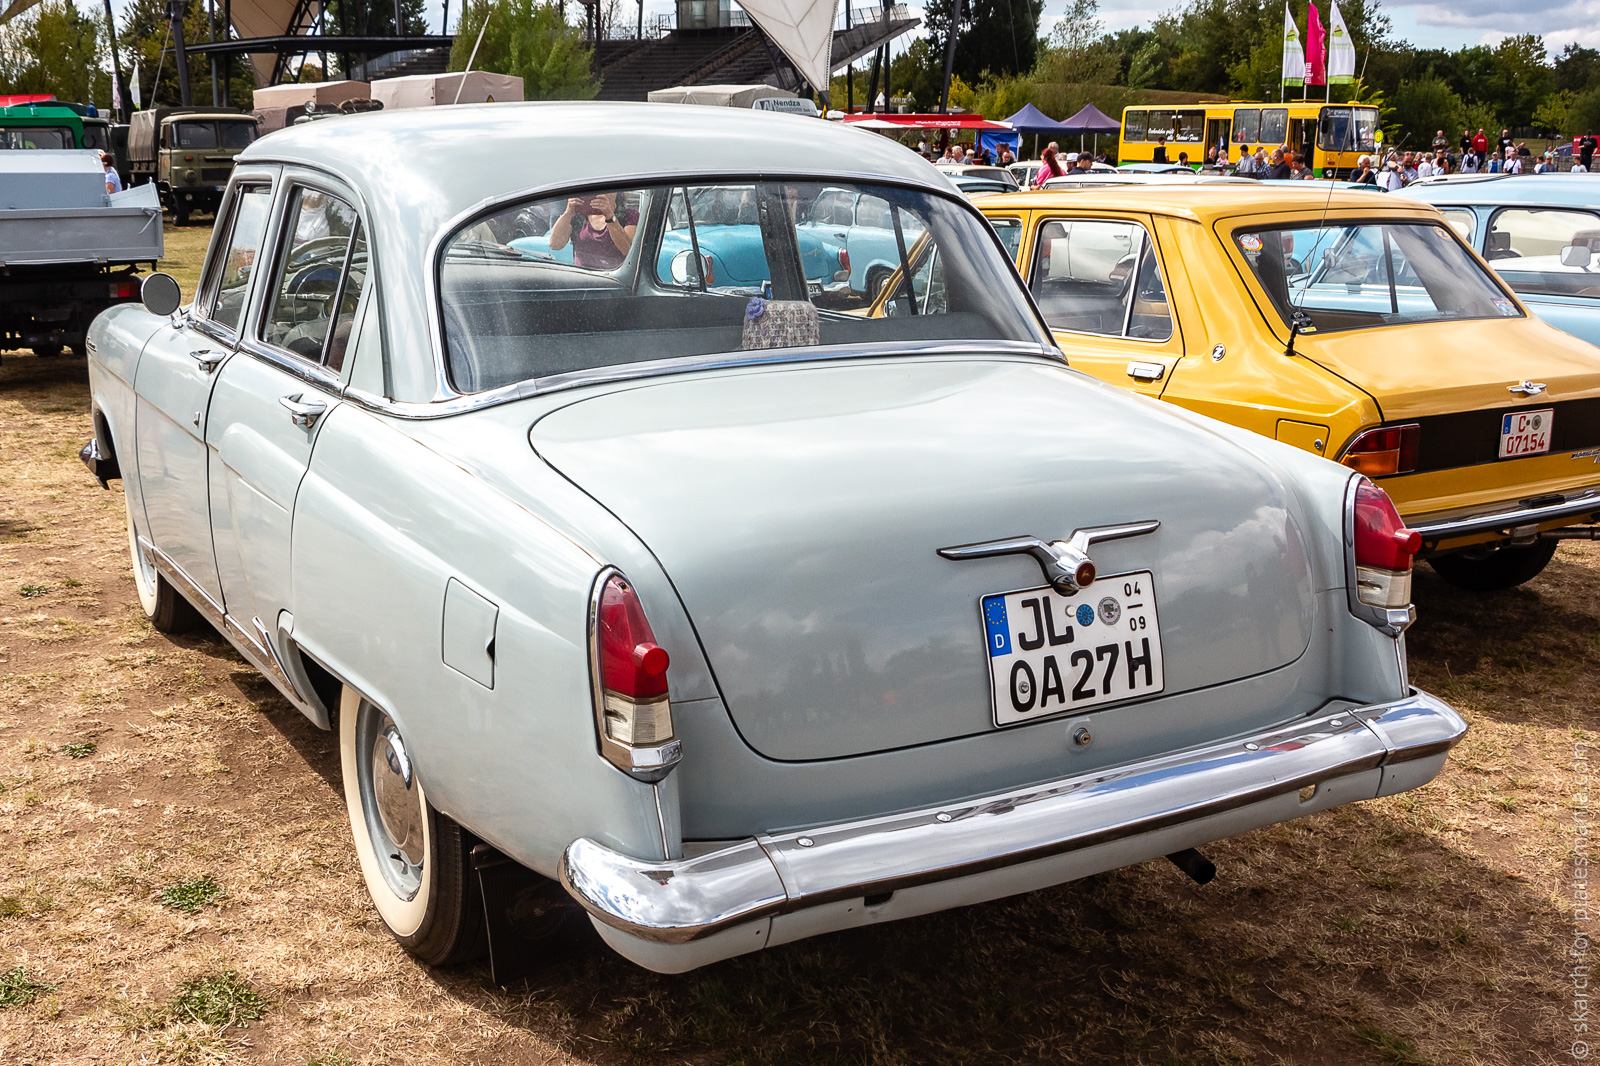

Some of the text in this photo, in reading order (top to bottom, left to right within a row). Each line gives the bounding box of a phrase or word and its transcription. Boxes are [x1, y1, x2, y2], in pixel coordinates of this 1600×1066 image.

[773, 99, 801, 107] Nendza
[1518, 415, 1526, 432] C
[1506, 431, 1545, 454] 07154
[1123, 581, 1141, 597] 04
[1018, 596, 1075, 651] JL
[1129, 616, 1147, 631] 09
[994, 633, 1005, 649] D
